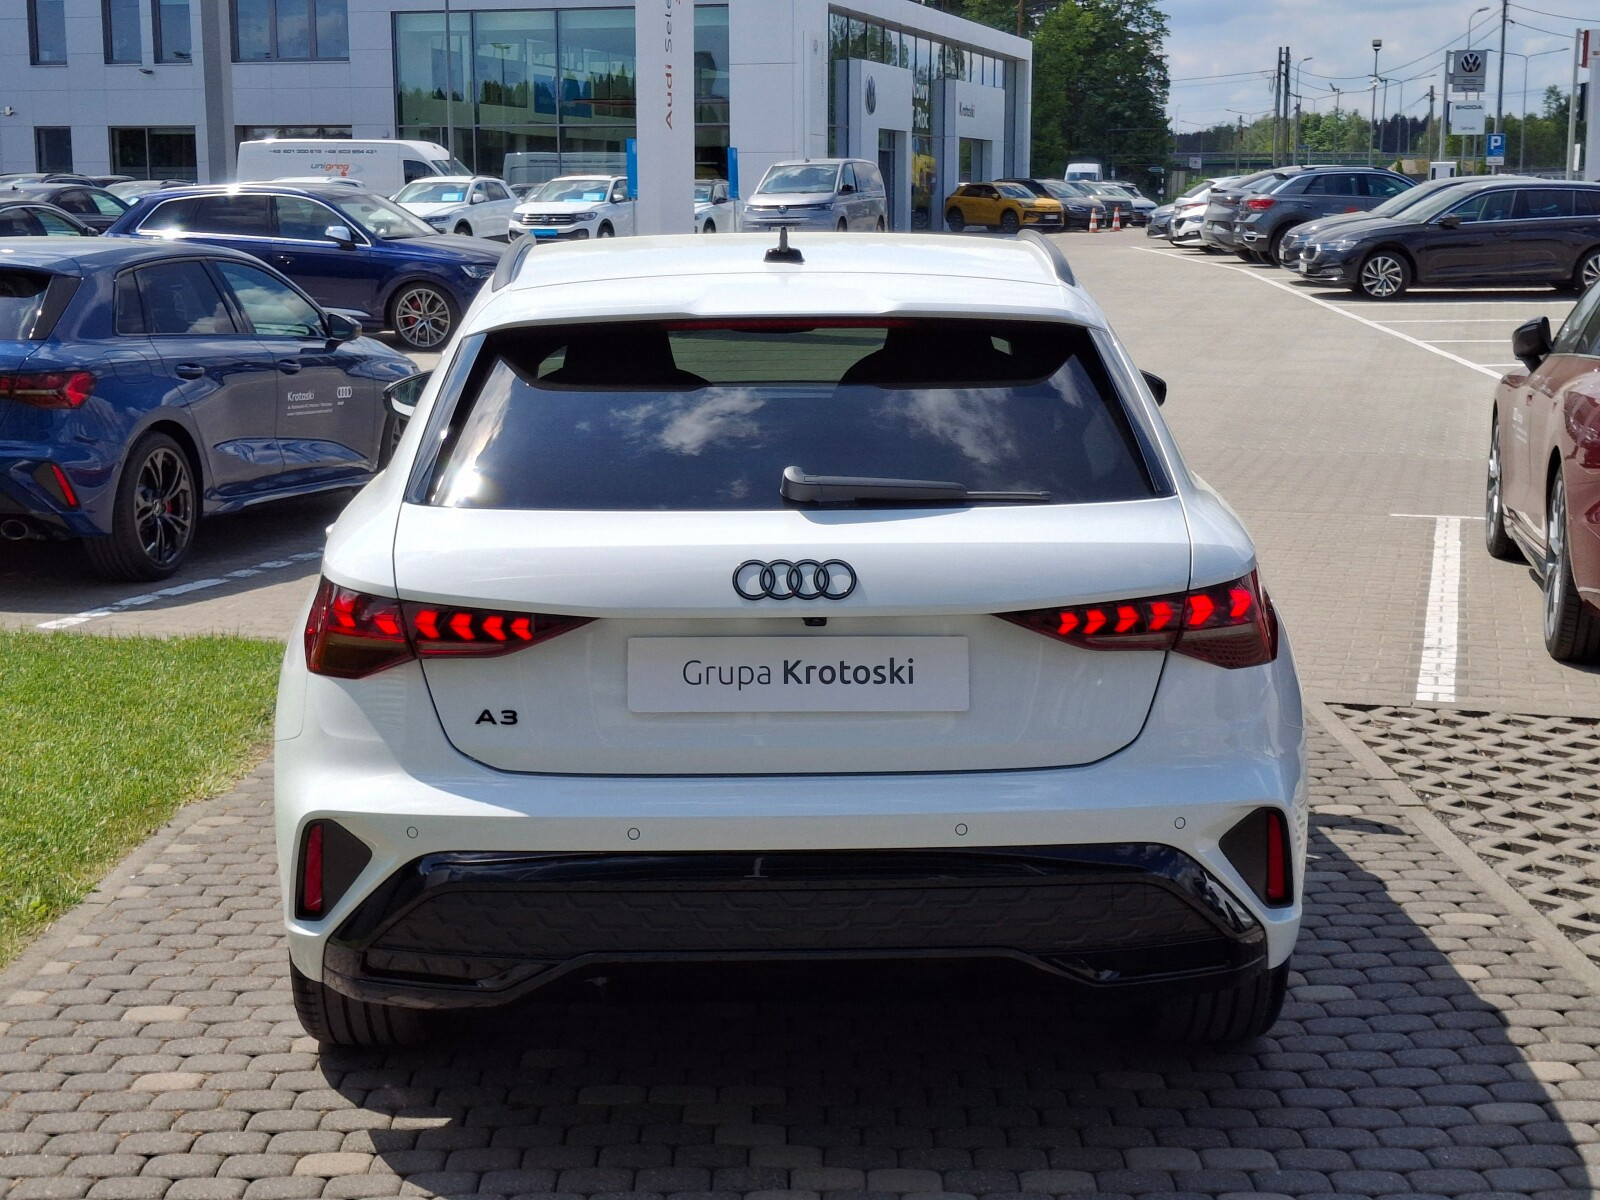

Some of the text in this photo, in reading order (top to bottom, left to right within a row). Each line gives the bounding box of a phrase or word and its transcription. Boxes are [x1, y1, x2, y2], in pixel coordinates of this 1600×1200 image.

[665, 64, 673, 130] Audi
[1490, 136, 1502, 150] P
[310, 162, 349, 171] unigreg
[287, 390, 315, 401] Krotoski
[682, 657, 914, 691] Grupa Krotoski
[475, 709, 518, 725] A3
